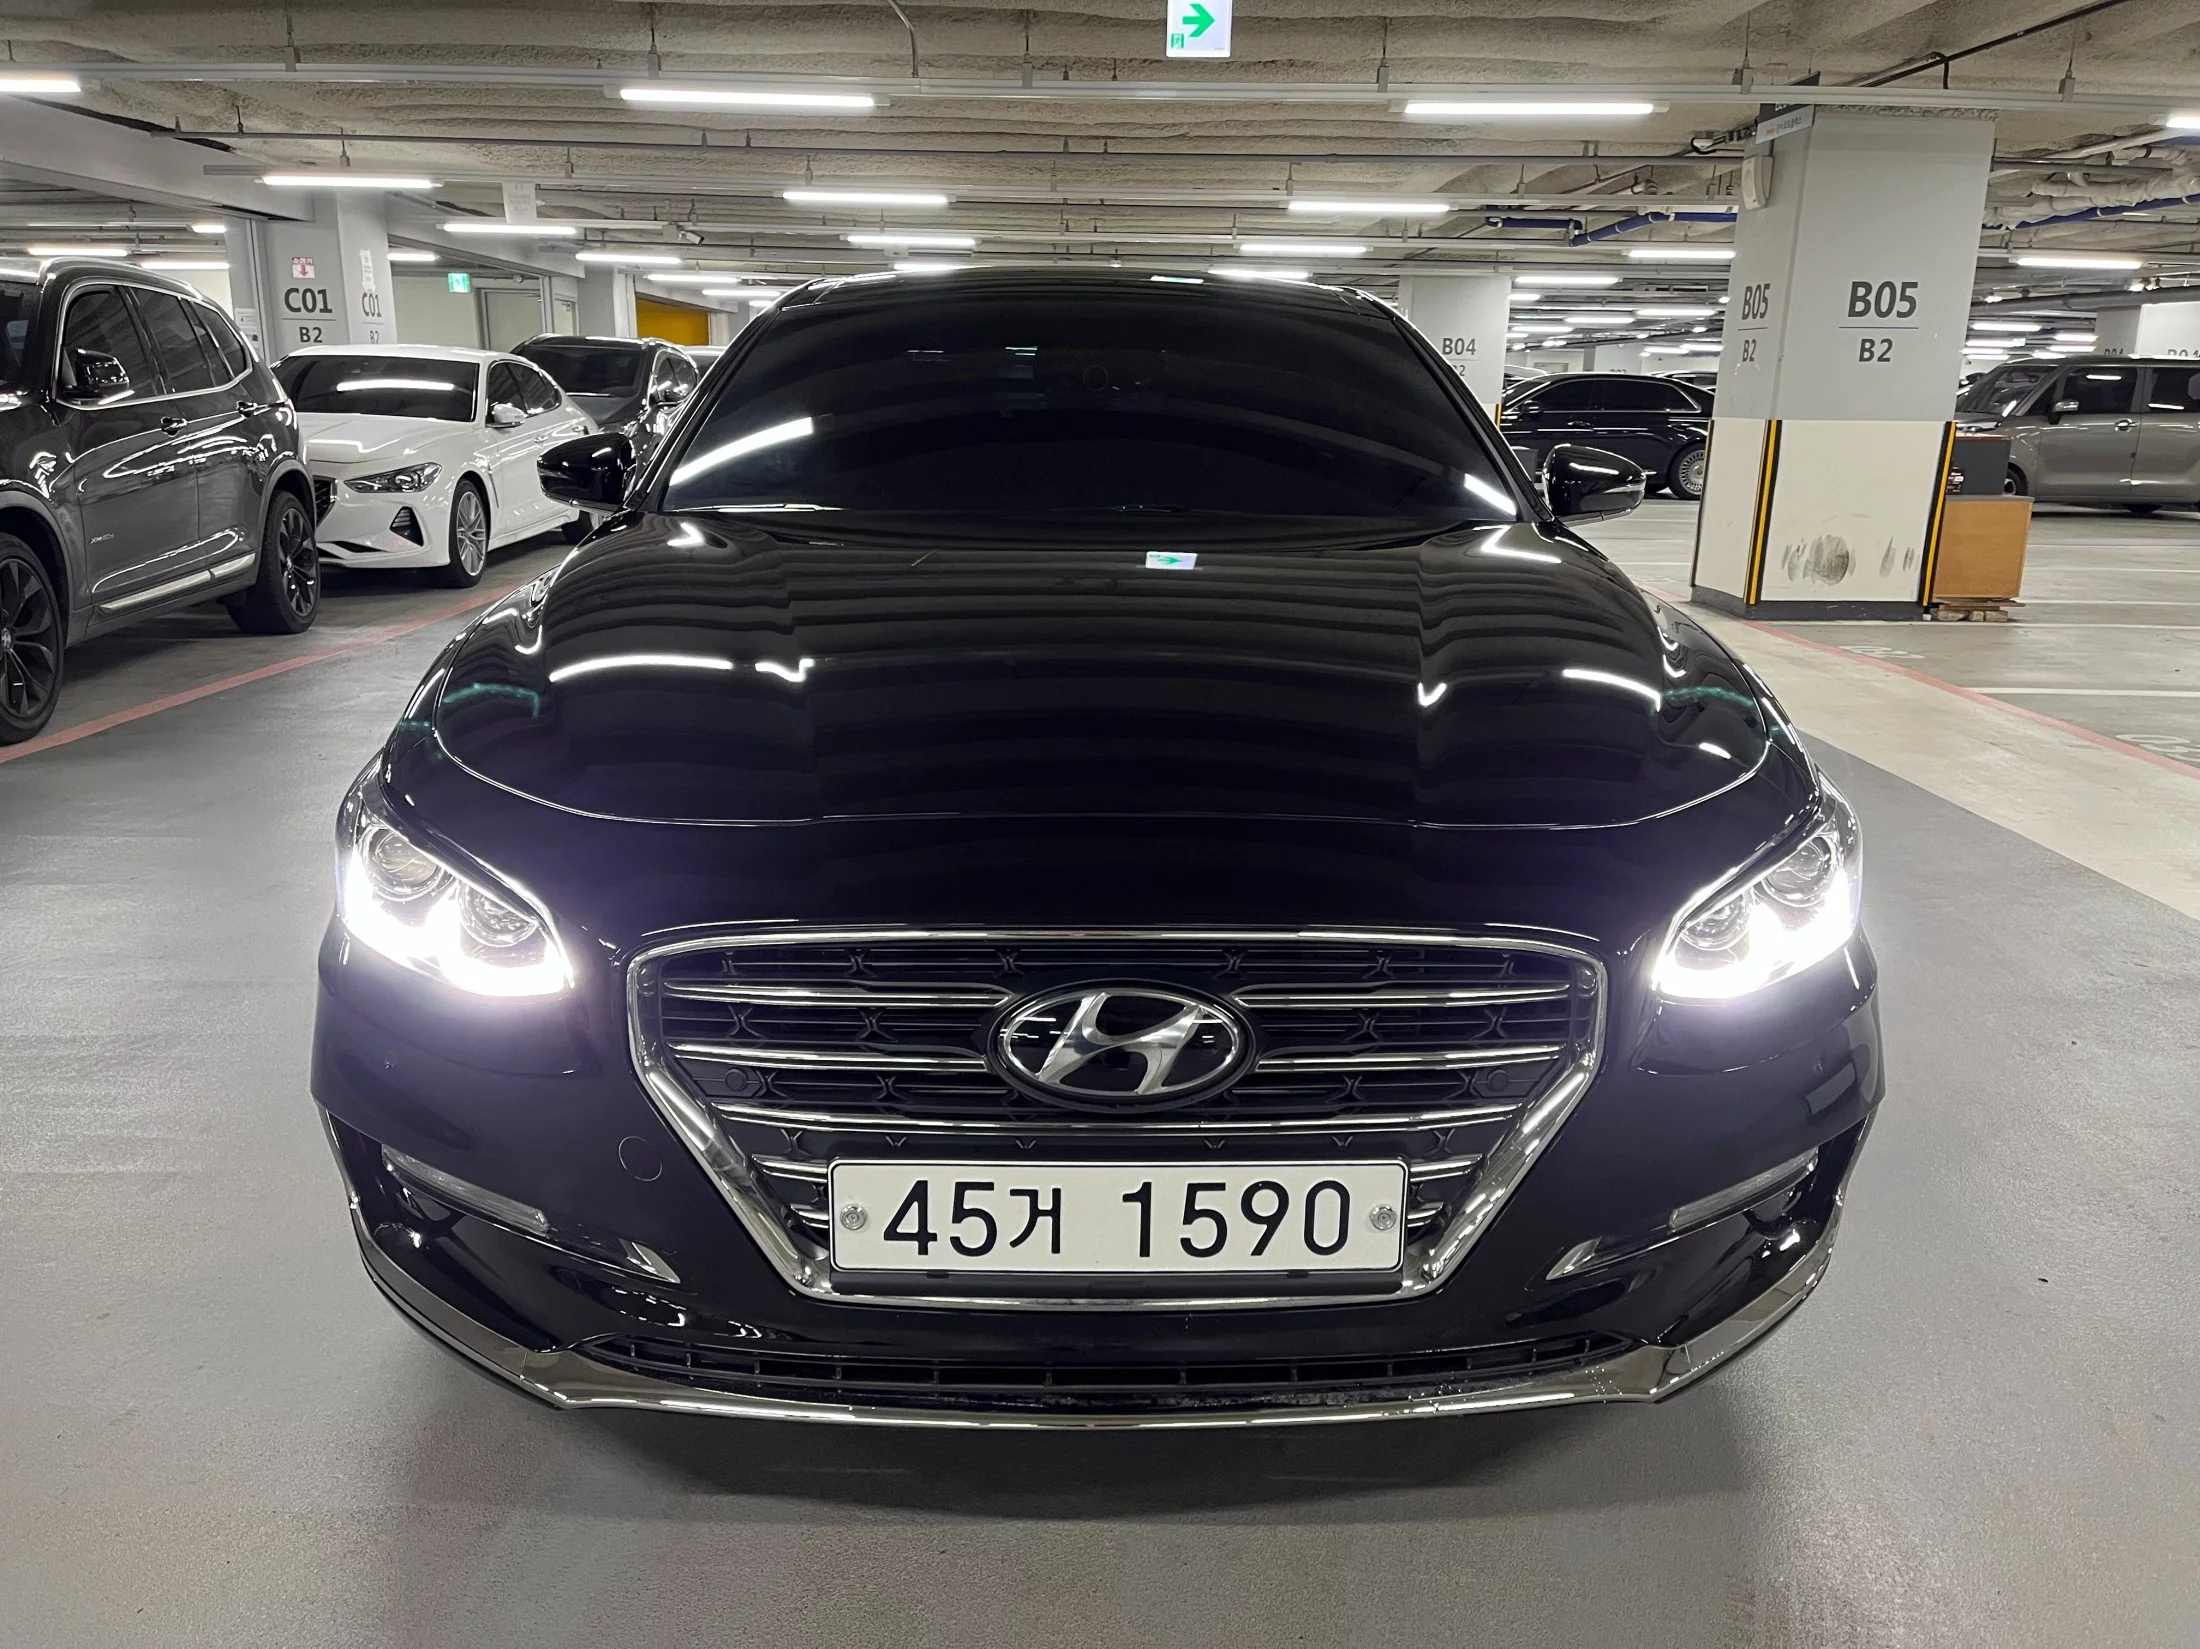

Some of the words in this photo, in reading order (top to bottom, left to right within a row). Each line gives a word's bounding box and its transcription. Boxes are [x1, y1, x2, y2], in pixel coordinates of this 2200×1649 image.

[284, 288, 333, 313] C01
[361, 292, 382, 317] C01
[1741, 283, 1770, 320] B05
[1847, 281, 1919, 318] B05
[299, 327, 323, 343] B2
[1442, 337, 1476, 355] B04
[1742, 339, 1757, 362] B2
[1858, 338, 1893, 362] B2
[1452, 364, 1466, 377] 2
[883, 1179, 1062, 1257] 45거
[1122, 1179, 1351, 1258] 1590
